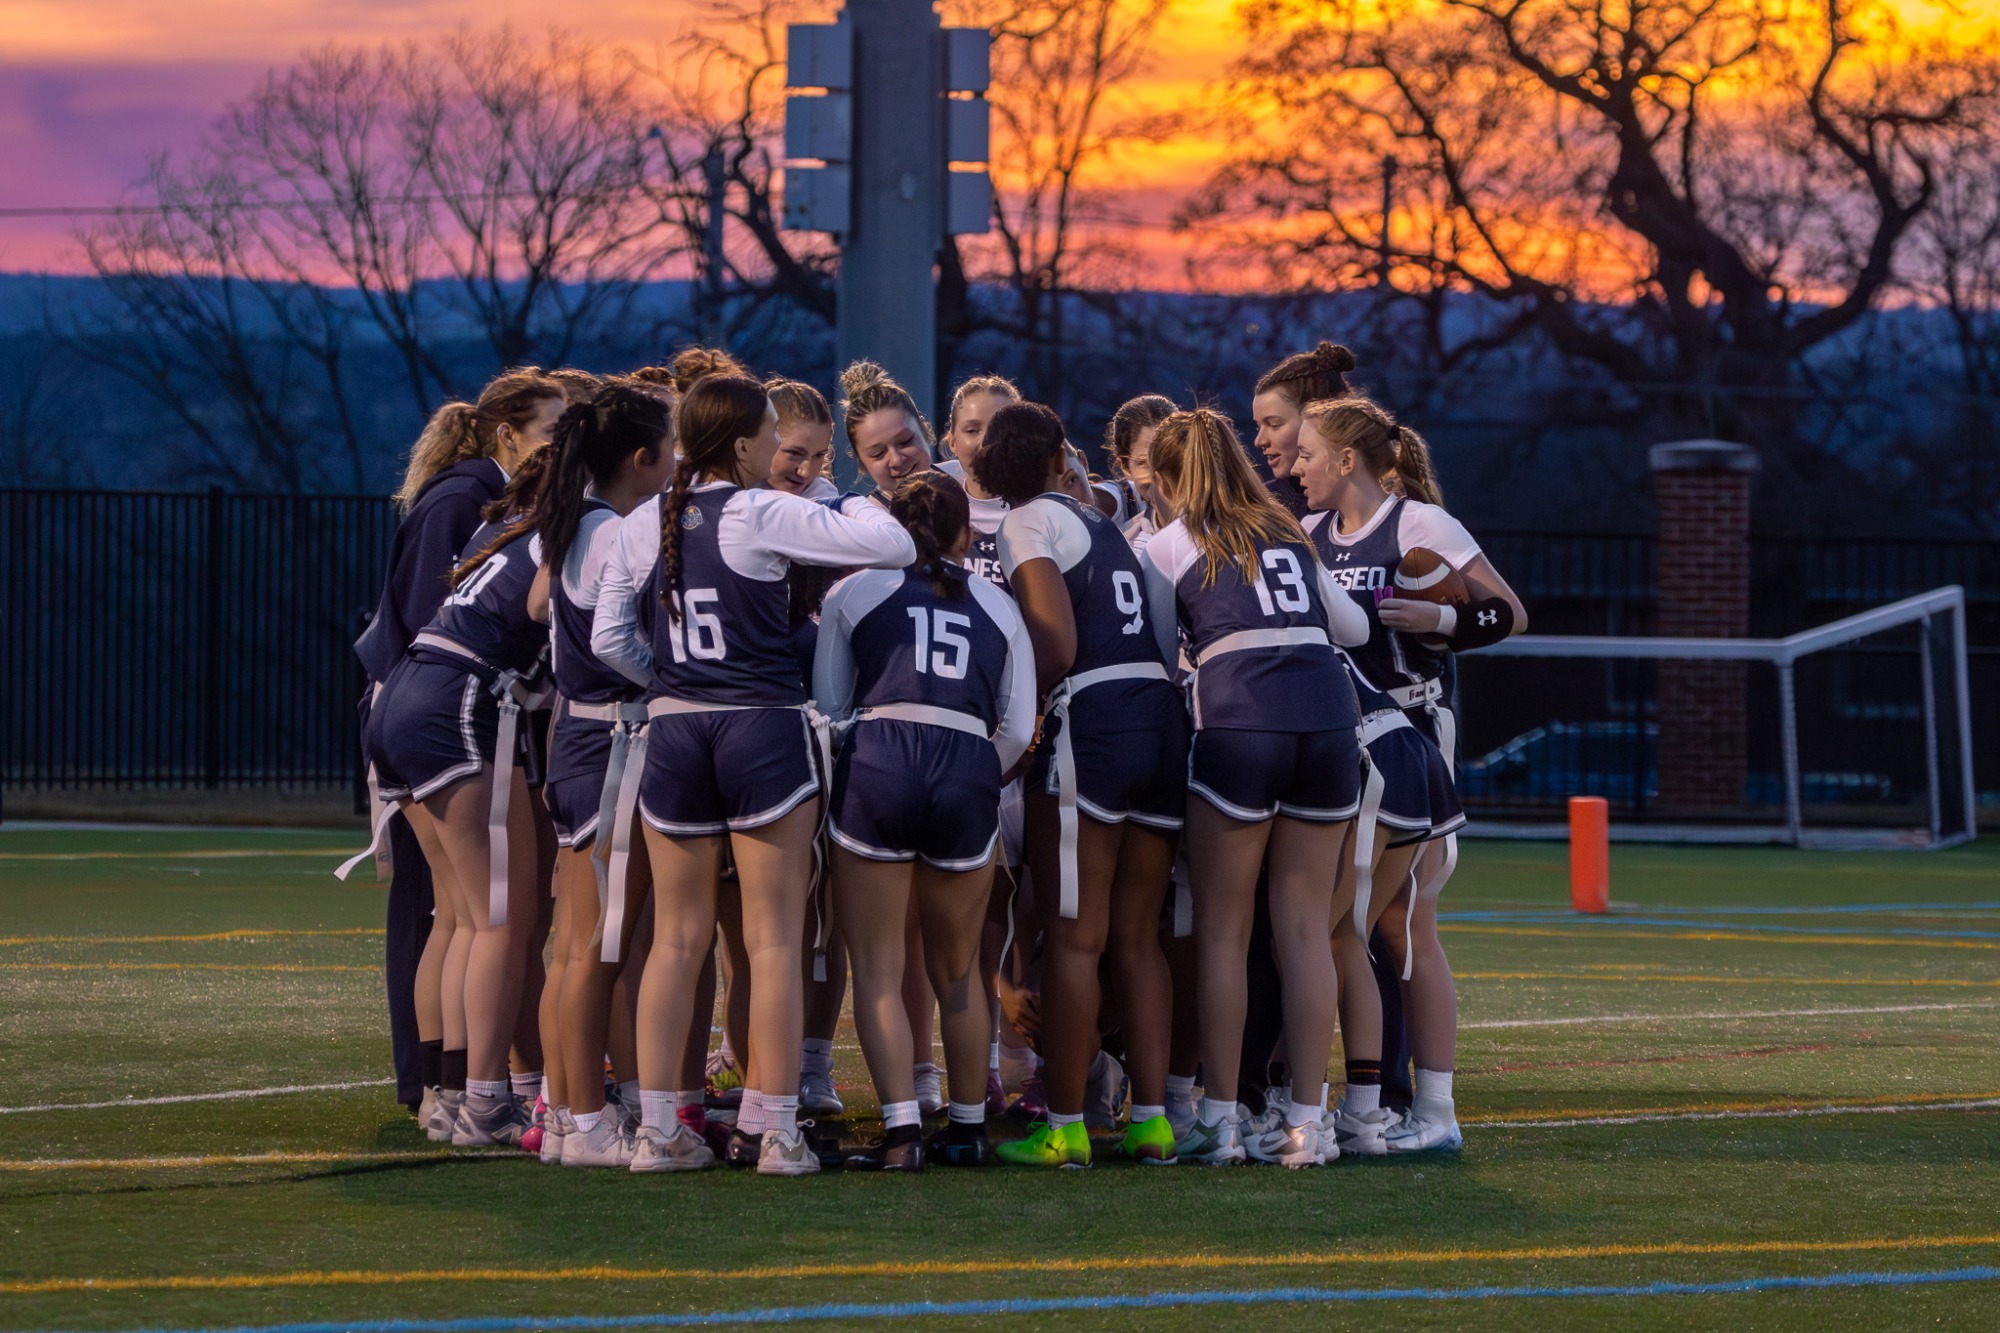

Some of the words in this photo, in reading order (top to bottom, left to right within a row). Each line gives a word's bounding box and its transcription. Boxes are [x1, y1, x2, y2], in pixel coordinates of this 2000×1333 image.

[1112, 570, 1144, 635] 9
[1236, 548, 1310, 616] 13
[668, 588, 727, 664] 16
[906, 606, 972, 680] 15
